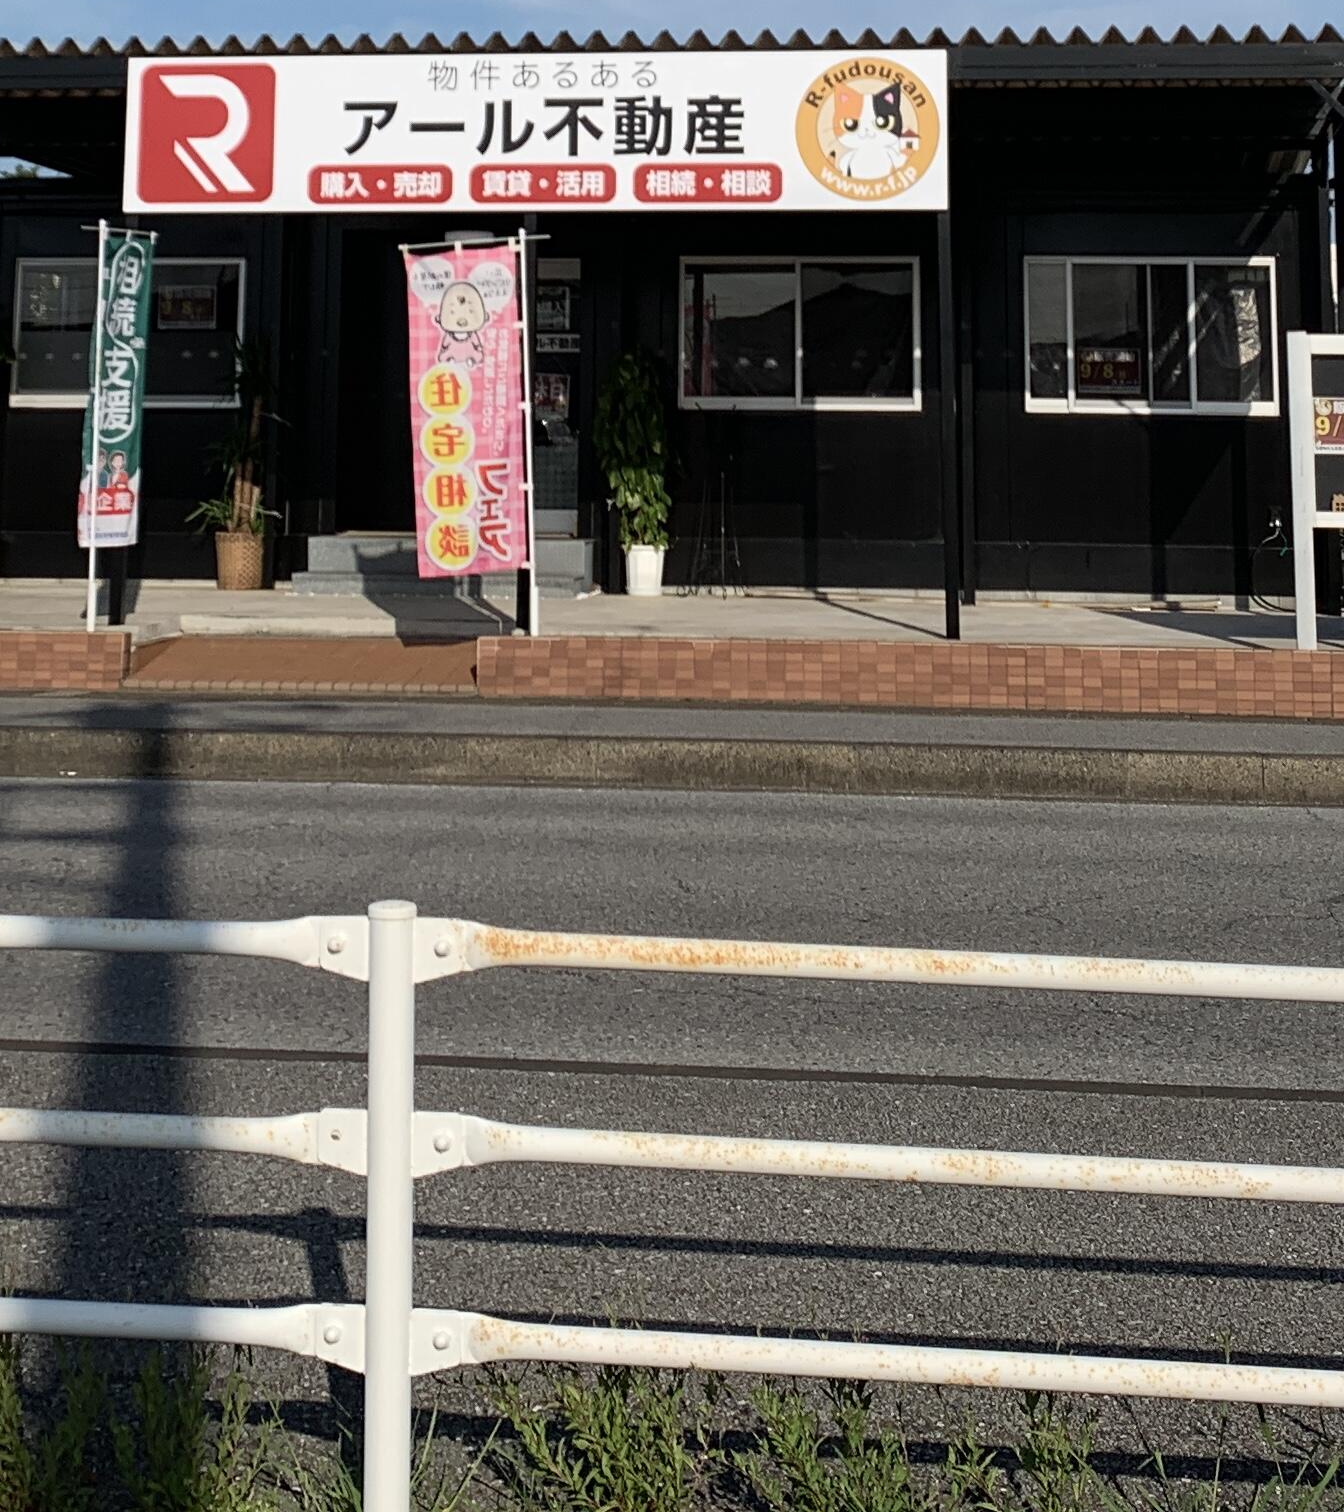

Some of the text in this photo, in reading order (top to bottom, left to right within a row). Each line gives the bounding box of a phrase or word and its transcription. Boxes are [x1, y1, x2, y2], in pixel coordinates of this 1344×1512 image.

[427, 59, 661, 92] 物件あるある
[805, 61, 928, 109] R-fudousan
[158, 73, 257, 195] R
[343, 94, 747, 158] アール不動産
[321, 170, 444, 200] 購入・売却
[481, 168, 606, 198] 賃貸・活用
[645, 167, 774, 197] 相続・相談
[820, 166, 918, 197] www.r-f.jp
